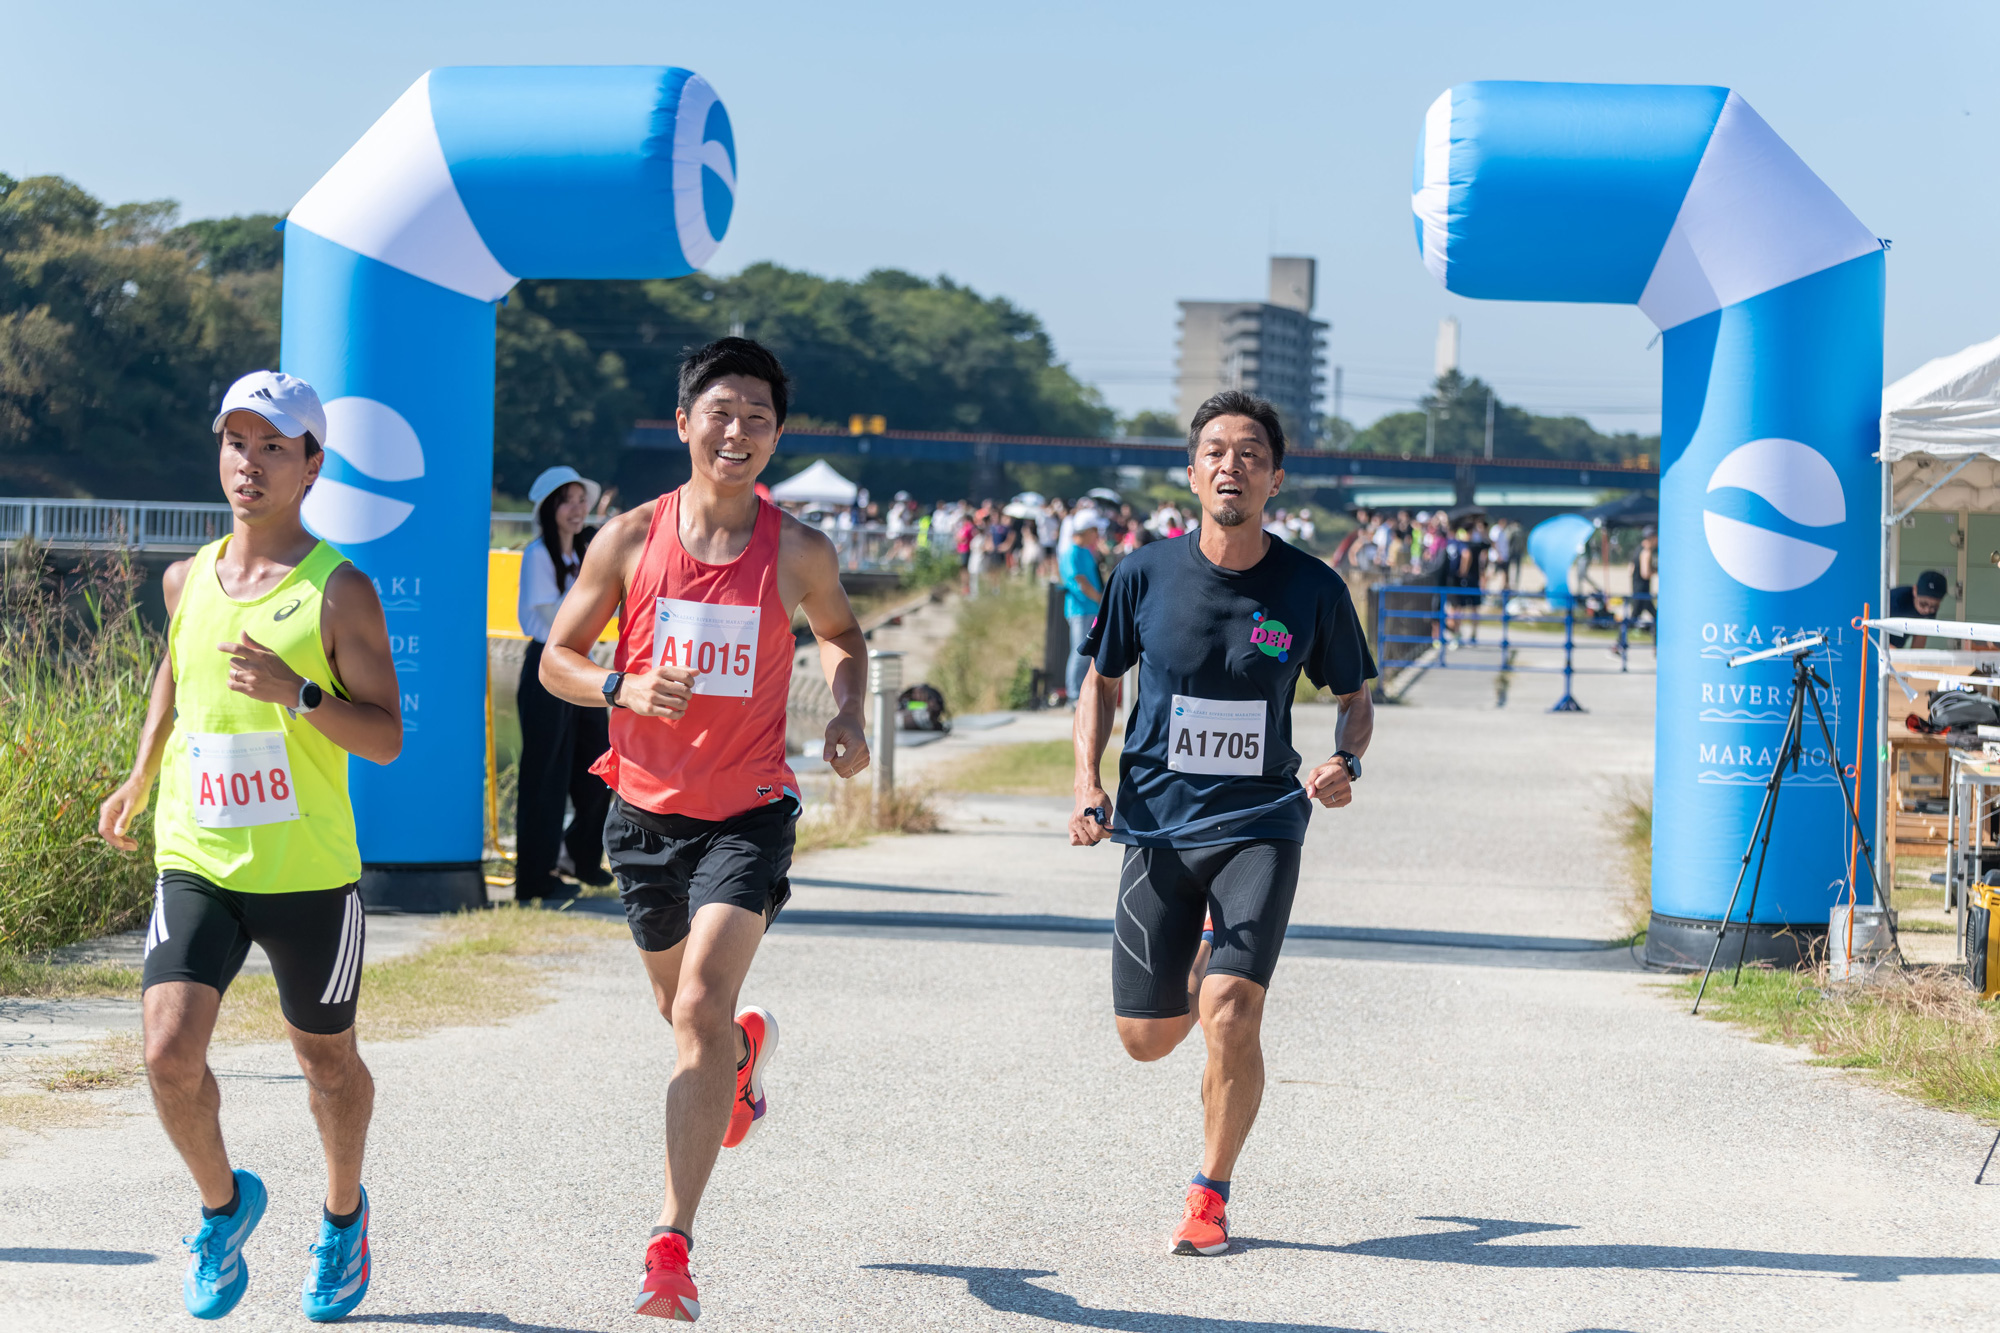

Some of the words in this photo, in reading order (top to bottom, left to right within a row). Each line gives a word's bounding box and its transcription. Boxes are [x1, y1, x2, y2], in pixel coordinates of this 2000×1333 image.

[1250, 627, 1293, 650] DEH
[660, 636, 751, 676] A1015
[1702, 683, 1841, 706] RIVERSIDE
[1175, 728, 1259, 759] A1705
[1699, 743, 1841, 767] MARAHO
[200, 768, 290, 806] A1018
